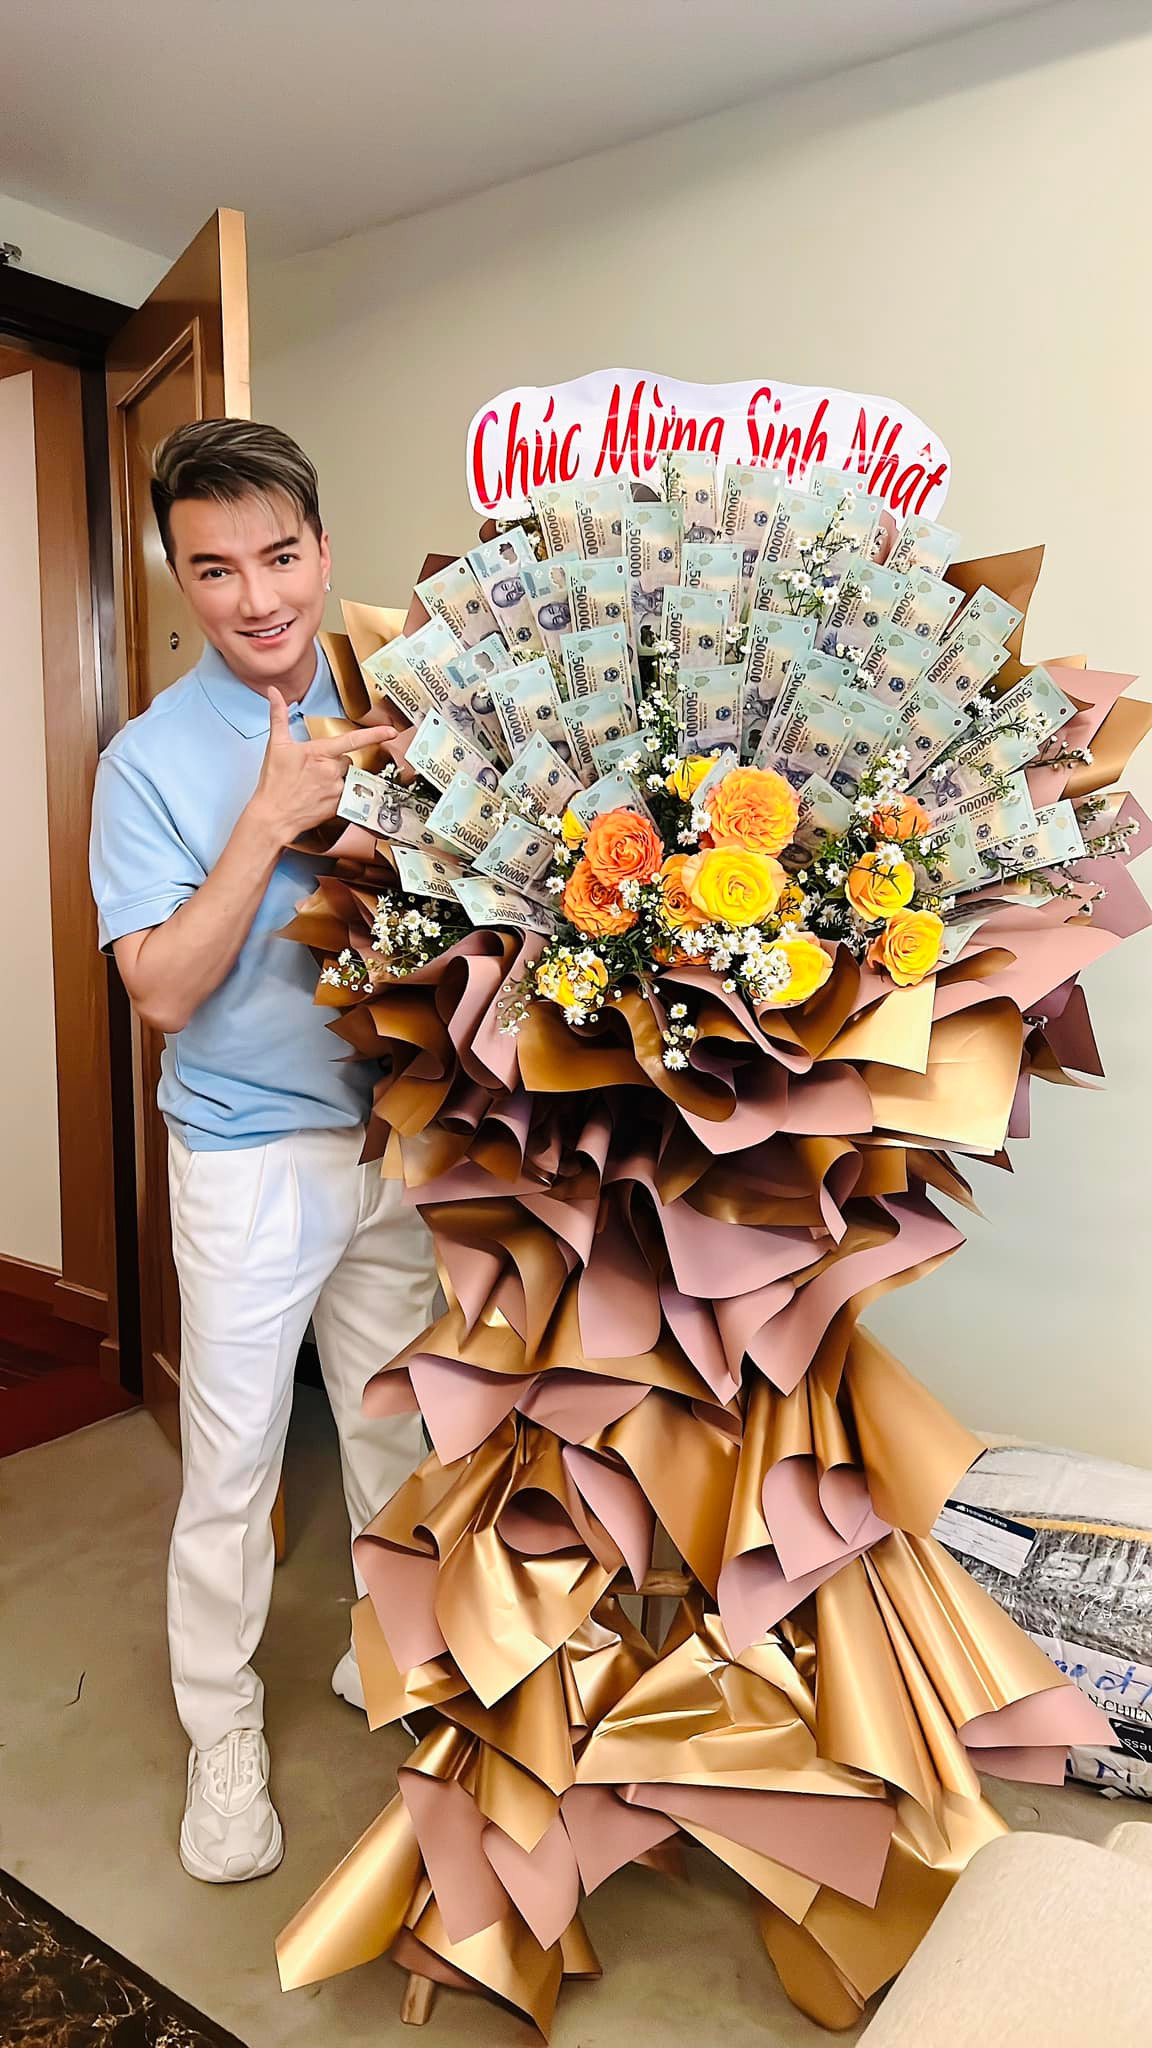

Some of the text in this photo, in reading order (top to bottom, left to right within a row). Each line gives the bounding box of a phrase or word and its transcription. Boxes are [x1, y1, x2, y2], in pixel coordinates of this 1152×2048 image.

[473, 395, 582, 510] Chúc
[737, 386, 830, 485] Sinh
[545, 507, 563, 552] 500000
[581, 507, 598, 555] 500000
[725, 489, 741, 535] 500000
[630, 529, 642, 577] 500000
[767, 514, 790, 562] 500000
[415, 659, 449, 701] 500000
[750, 635, 768, 683] 500000
[927, 642, 965, 683] 500000
[384, 673, 419, 712] 500000
[687, 692, 698, 737] 500000
[502, 697, 526, 743] 500000
[572, 721, 593, 764] 500000
[782, 714, 808, 754] 500000
[450, 822, 488, 851] 500000
[495, 860, 529, 885] 500000
